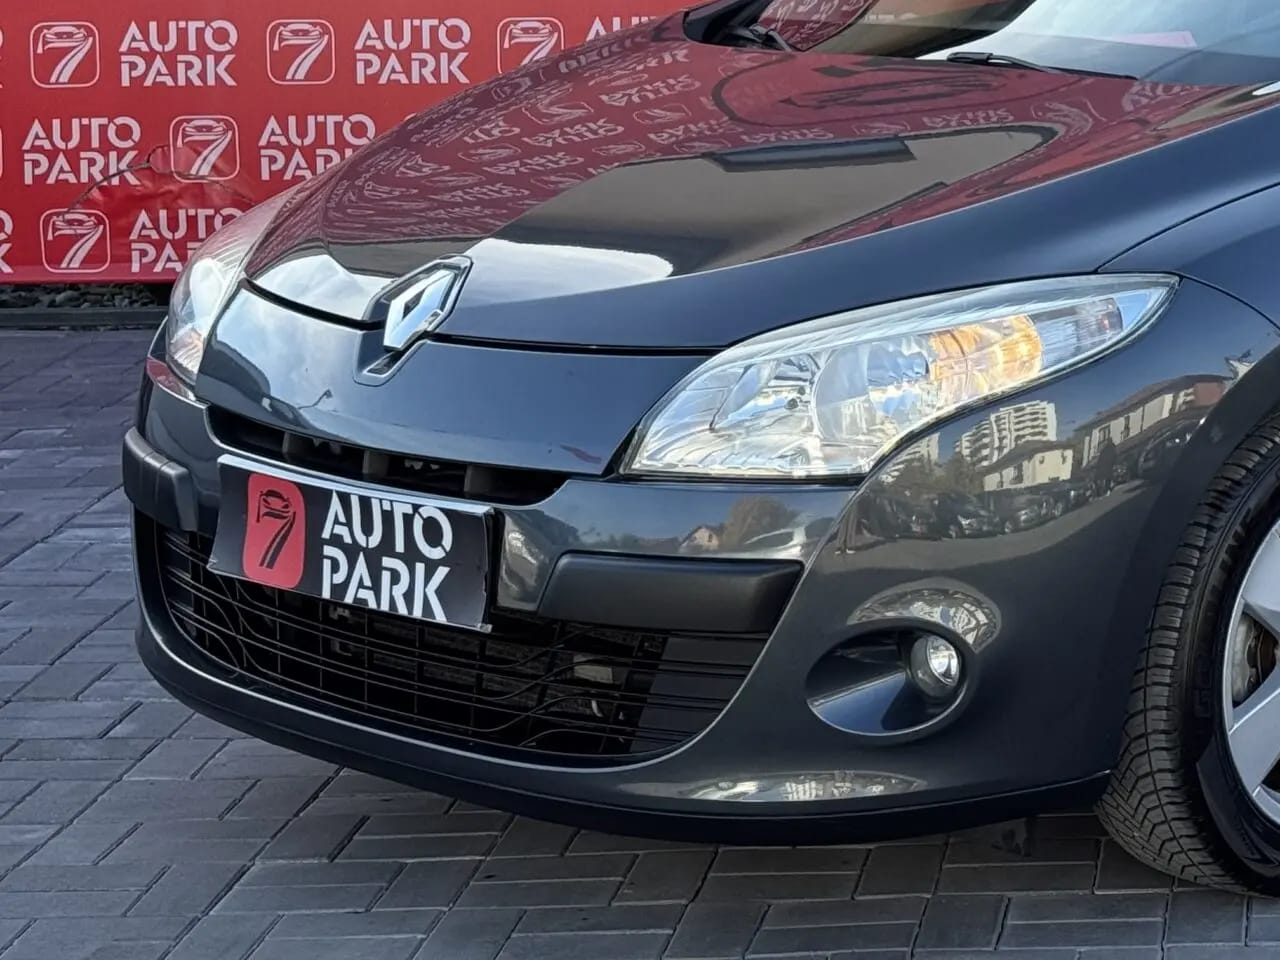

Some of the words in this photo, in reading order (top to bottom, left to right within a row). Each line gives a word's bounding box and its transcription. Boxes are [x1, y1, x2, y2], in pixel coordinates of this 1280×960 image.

[119, 19, 238, 52] AUTO
[354, 17, 471, 50] AUTO
[120, 54, 237, 87] PARK
[356, 52, 470, 85] PARK
[22, 116, 141, 150] AUTO
[258, 113, 376, 146] AUTO
[23, 150, 141, 186] PARK
[320, 489, 453, 560] AUTO
[320, 544, 451, 622] PARK
